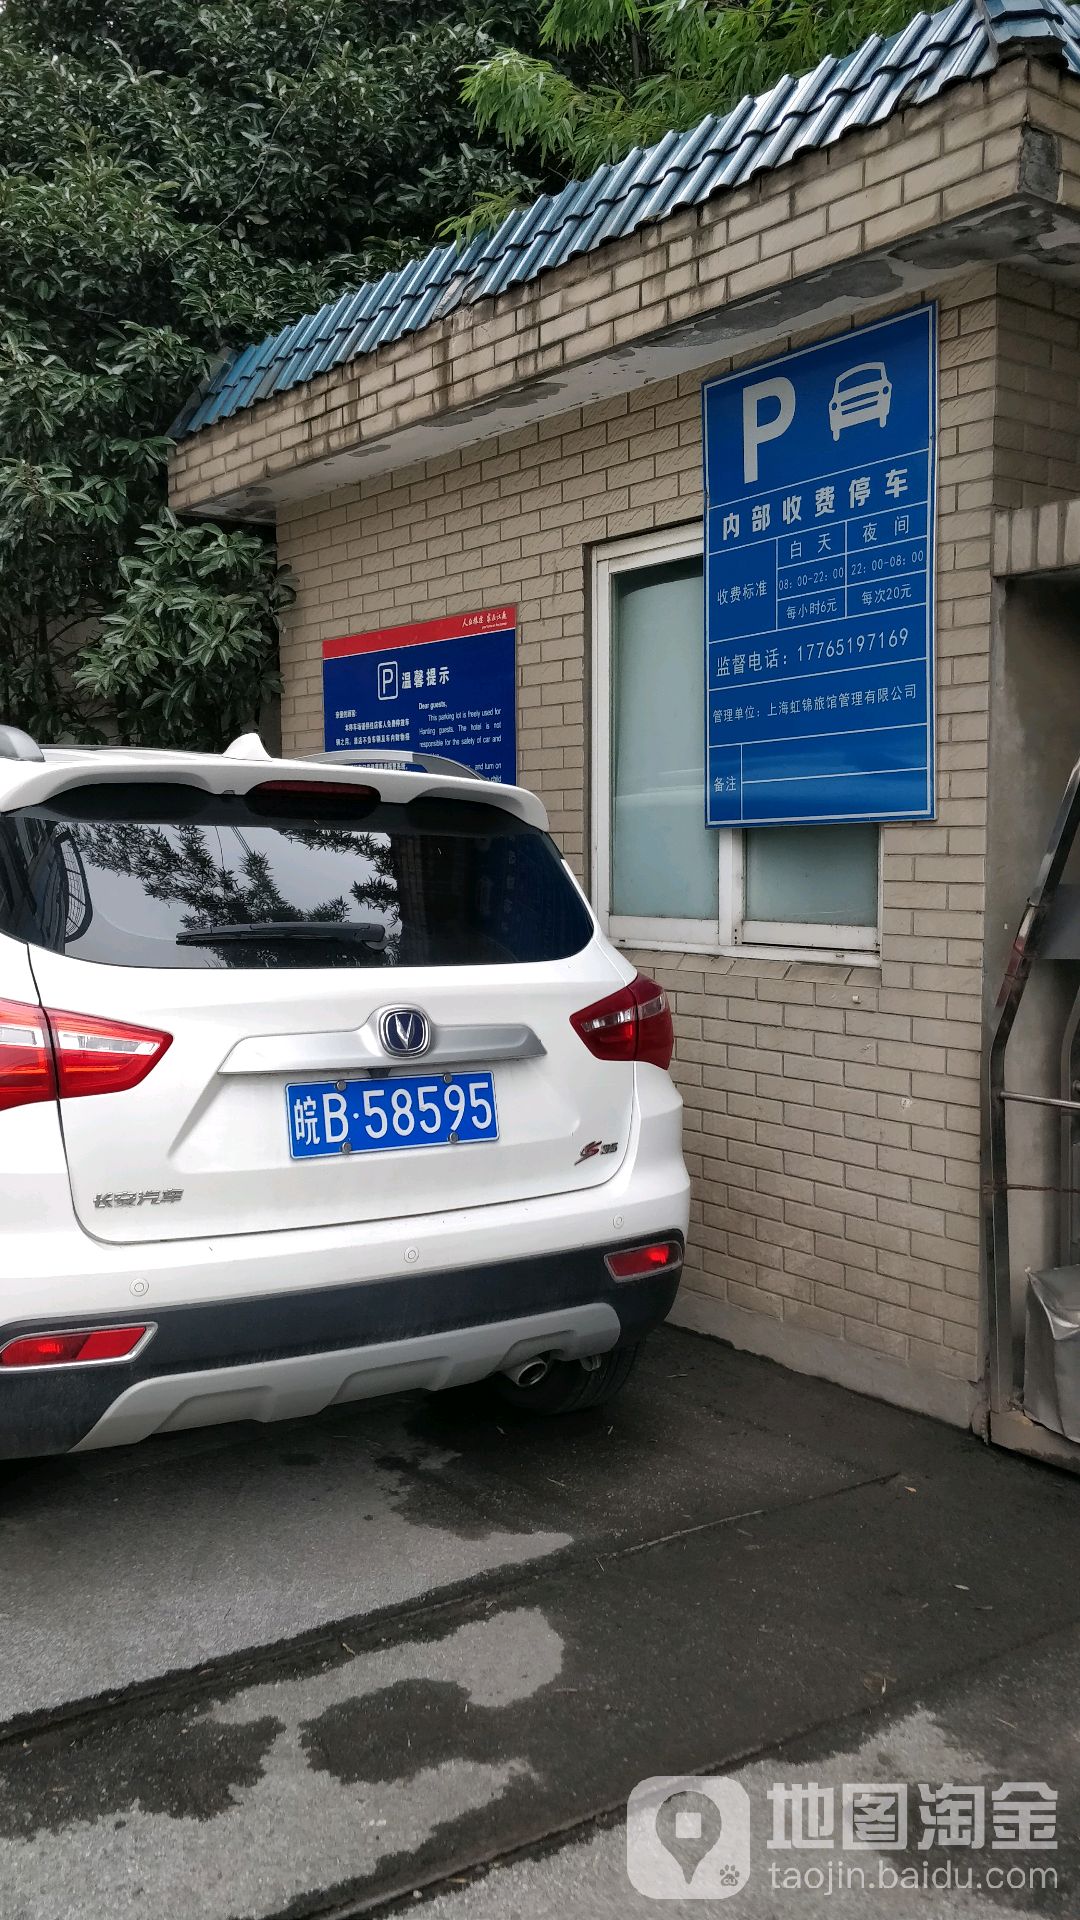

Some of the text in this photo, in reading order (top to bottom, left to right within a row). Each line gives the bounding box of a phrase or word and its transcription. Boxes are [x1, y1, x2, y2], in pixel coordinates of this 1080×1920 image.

[743, 377, 796, 484] P
[723, 468, 909, 541] 内部收费停车
[790, 515, 910, 560] 白天 夜间
[717, 579, 768, 606] 收费标准
[786, 583, 912, 620] 每小时6元 每次20元
[401, 666, 450, 690] 温馨提示
[418, 702, 430, 710] Dear
[438, 712, 454, 722] parking
[467, 710, 480, 718] freely
[482, 708, 493, 716] used
[458, 724, 467, 732] The
[470, 723, 481, 731] hotel
[493, 721, 501, 729] not
[420, 740, 443, 749] responsible
[444, 738, 452, 746] for
[461, 737, 475, 746] safety
[484, 762, 494, 770] turn
[713, 776, 737, 793] 备注
